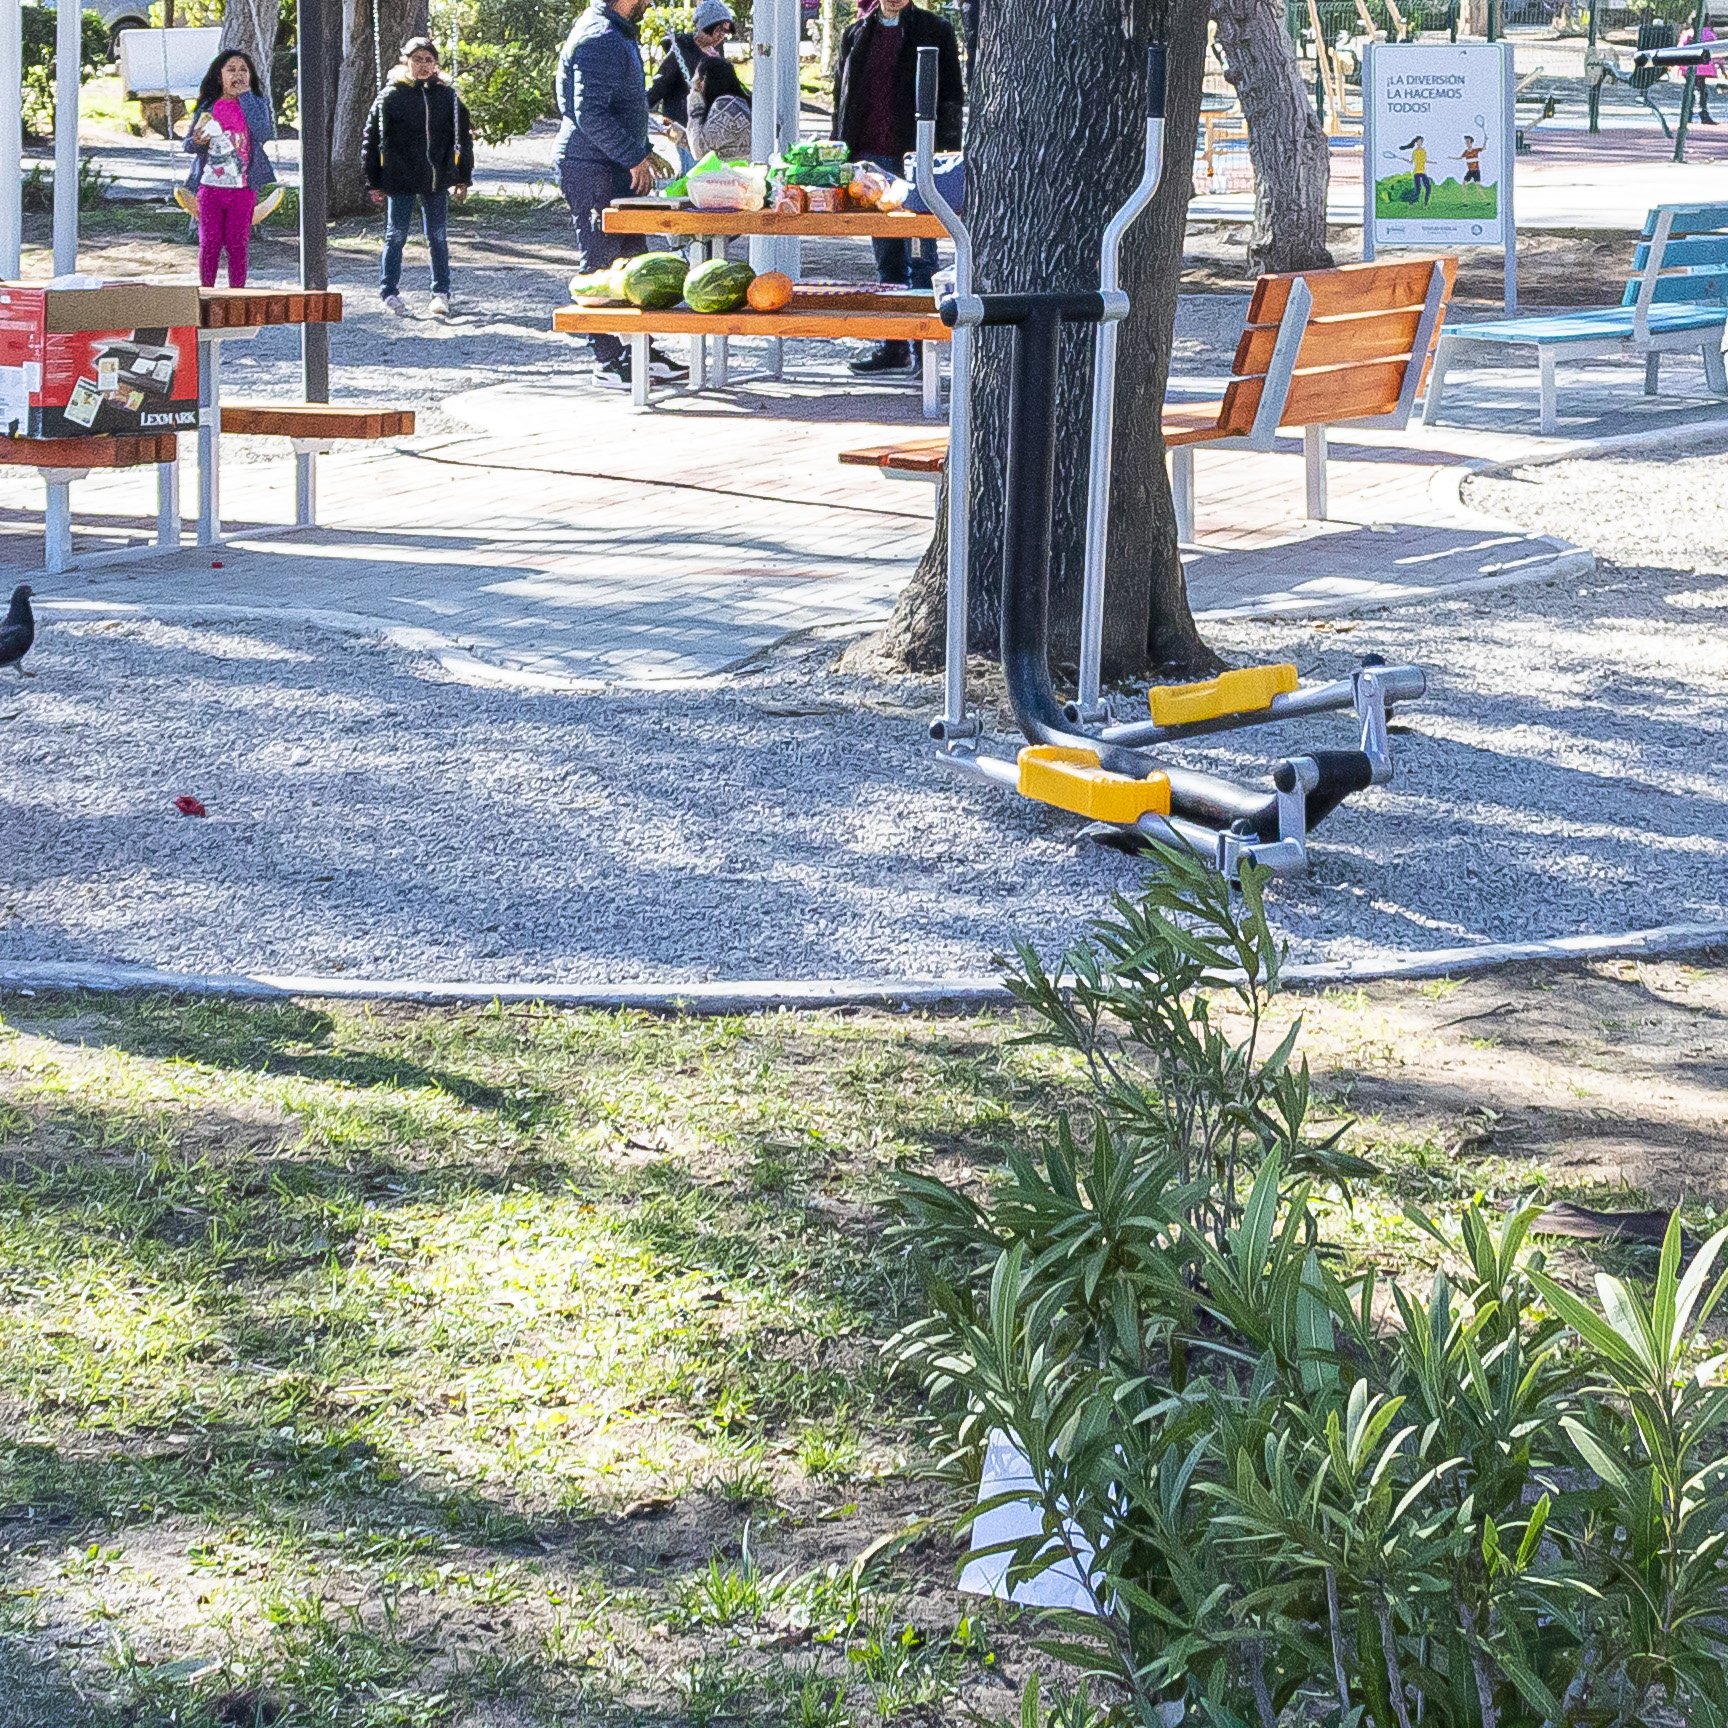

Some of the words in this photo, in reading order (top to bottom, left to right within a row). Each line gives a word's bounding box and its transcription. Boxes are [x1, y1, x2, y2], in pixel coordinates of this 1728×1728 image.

[1406, 73, 1465, 85] DIVERSIÓN
[1387, 88, 1402, 99] LA
[1404, 88, 1463, 99] HACEMOS
[1387, 102, 1431, 112] TODOS!
[140, 411, 197, 426] LEXMARK
